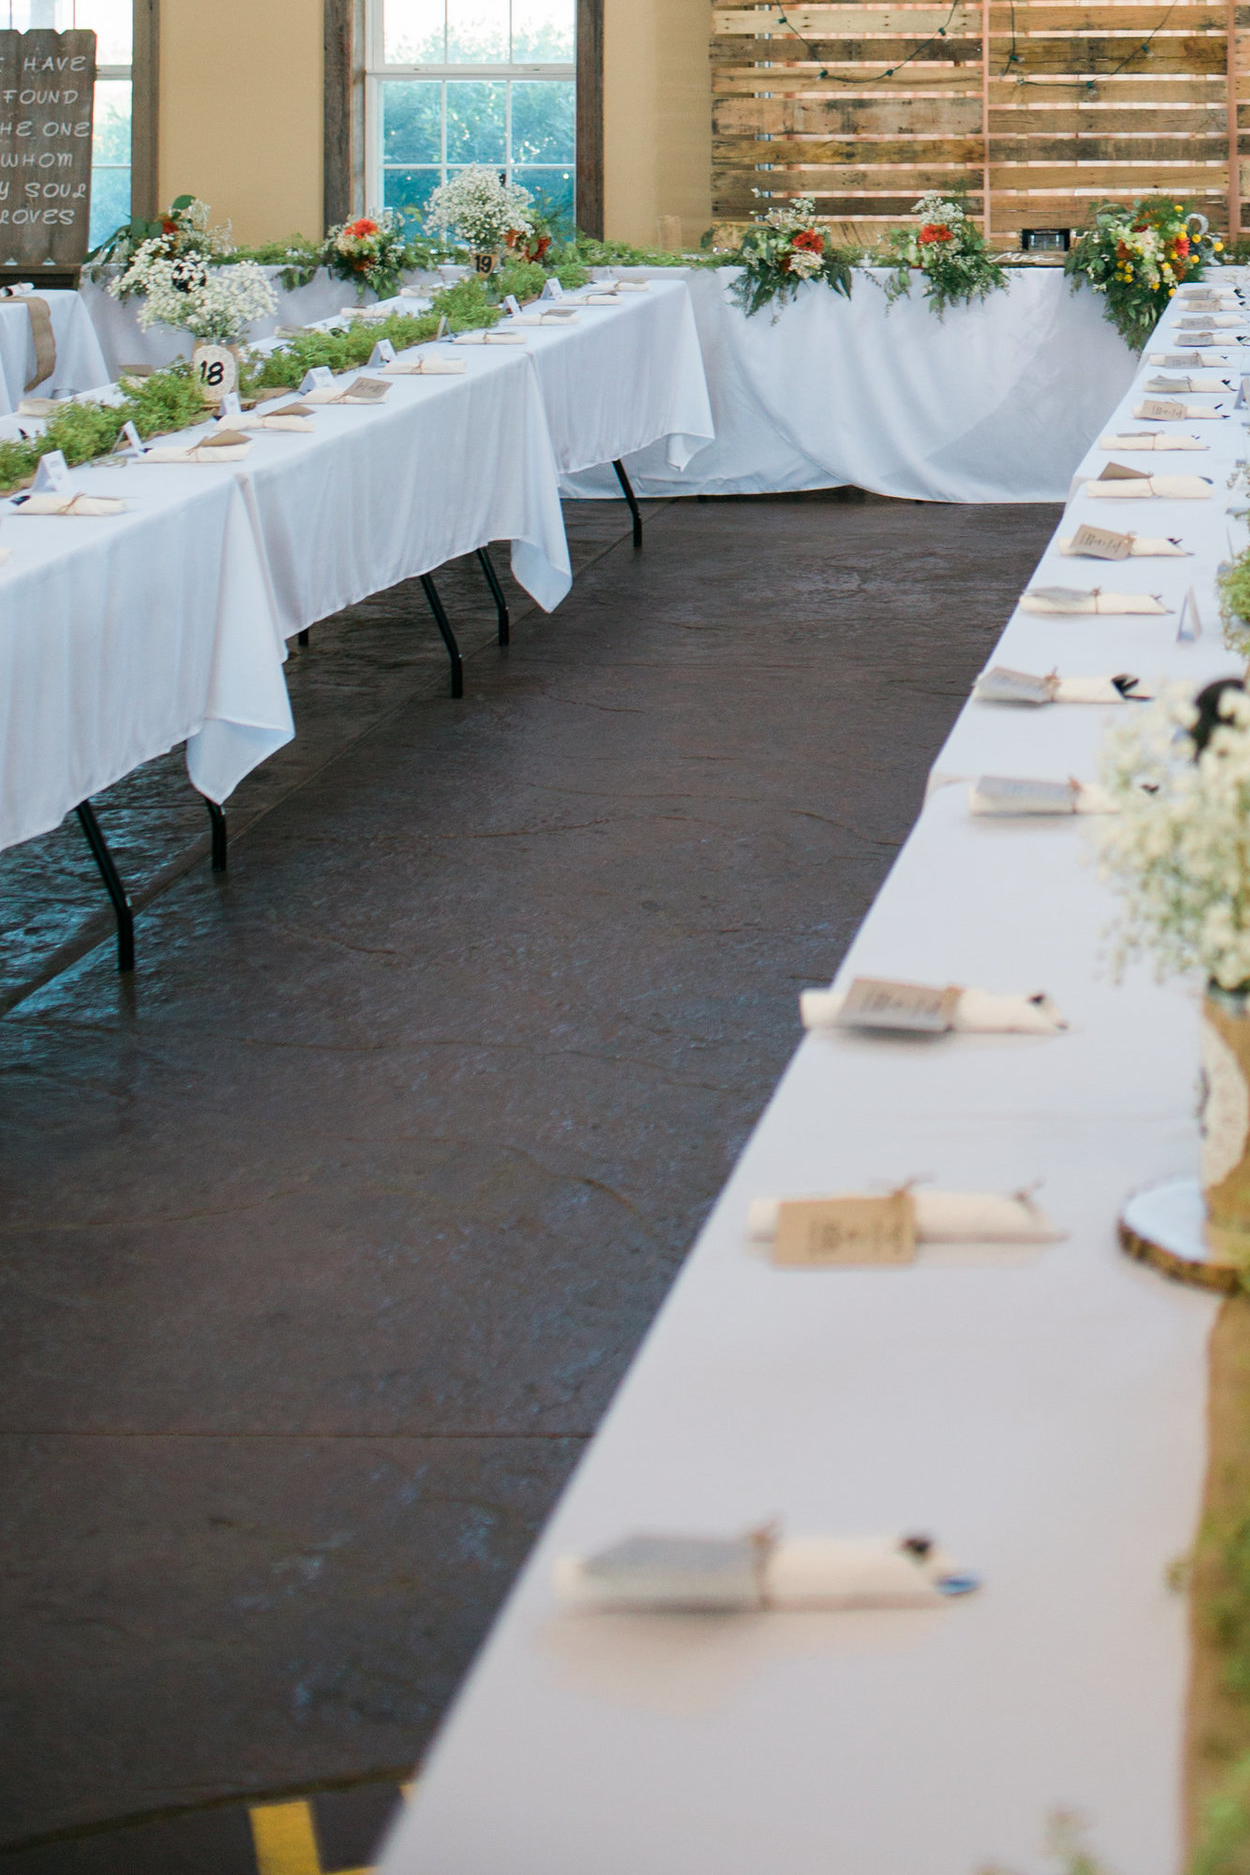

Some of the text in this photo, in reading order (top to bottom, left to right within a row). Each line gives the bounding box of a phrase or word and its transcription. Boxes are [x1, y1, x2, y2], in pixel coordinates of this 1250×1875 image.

[23, 55, 88, 72] HAVE
[2, 89, 79, 105] FOUND
[0, 120, 91, 138] HE ONE
[0, 152, 73, 168] WHOM
[0, 180, 87, 201] Y SOUL
[0, 208, 76, 226] LOVES
[474, 255, 493, 274] 19
[200, 359, 225, 387] 18
